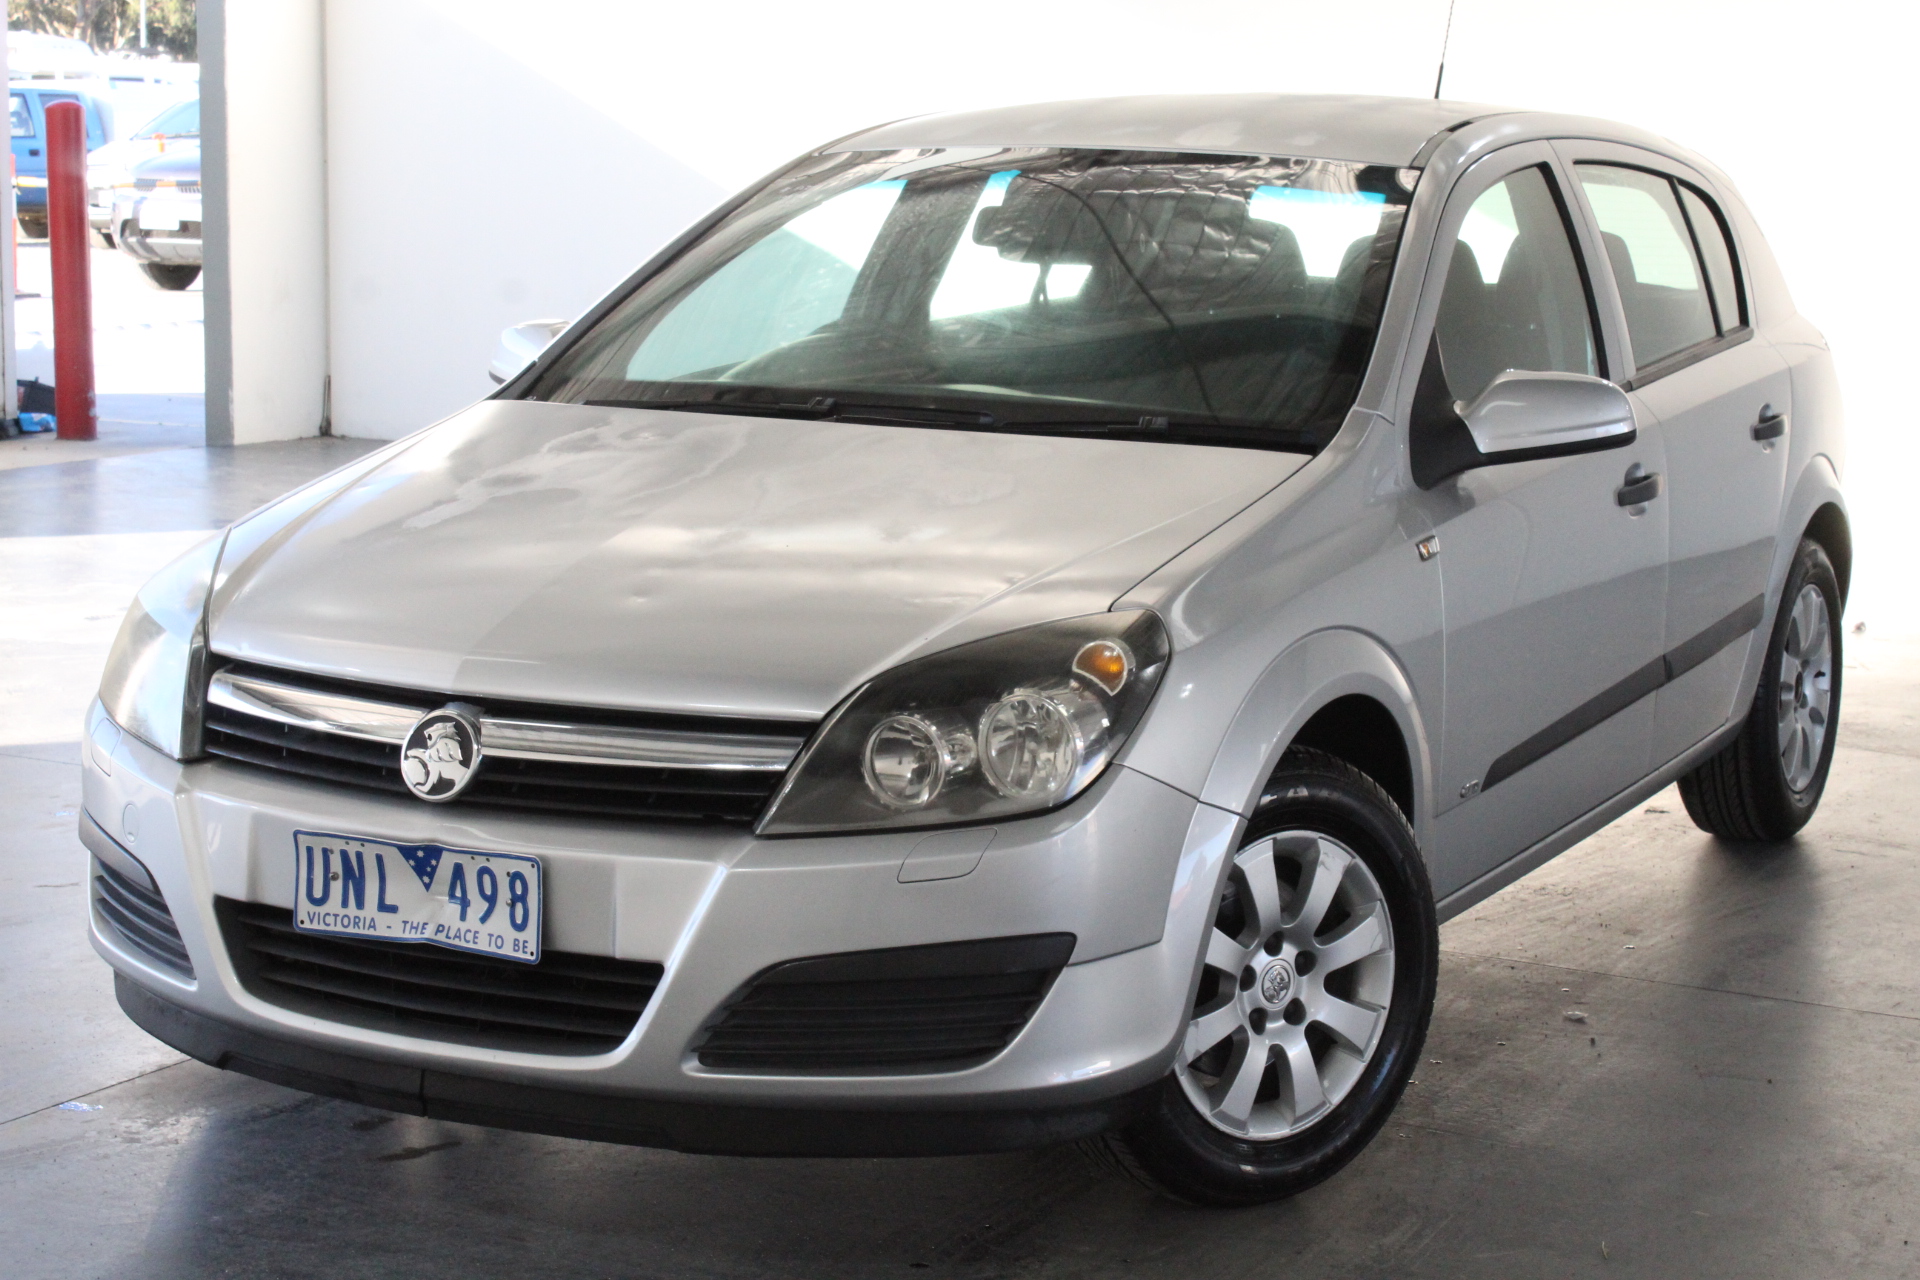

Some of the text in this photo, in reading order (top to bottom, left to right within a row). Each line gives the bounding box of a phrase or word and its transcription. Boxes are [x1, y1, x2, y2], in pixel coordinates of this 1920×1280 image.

[305, 845, 530, 933] UNL 498
[307, 910, 377, 932] VICTORIA
[401, 920, 429, 935] THE
[434, 923, 480, 945] PLACE
[487, 933, 505, 950] TO
[512, 938, 529, 954] BE
